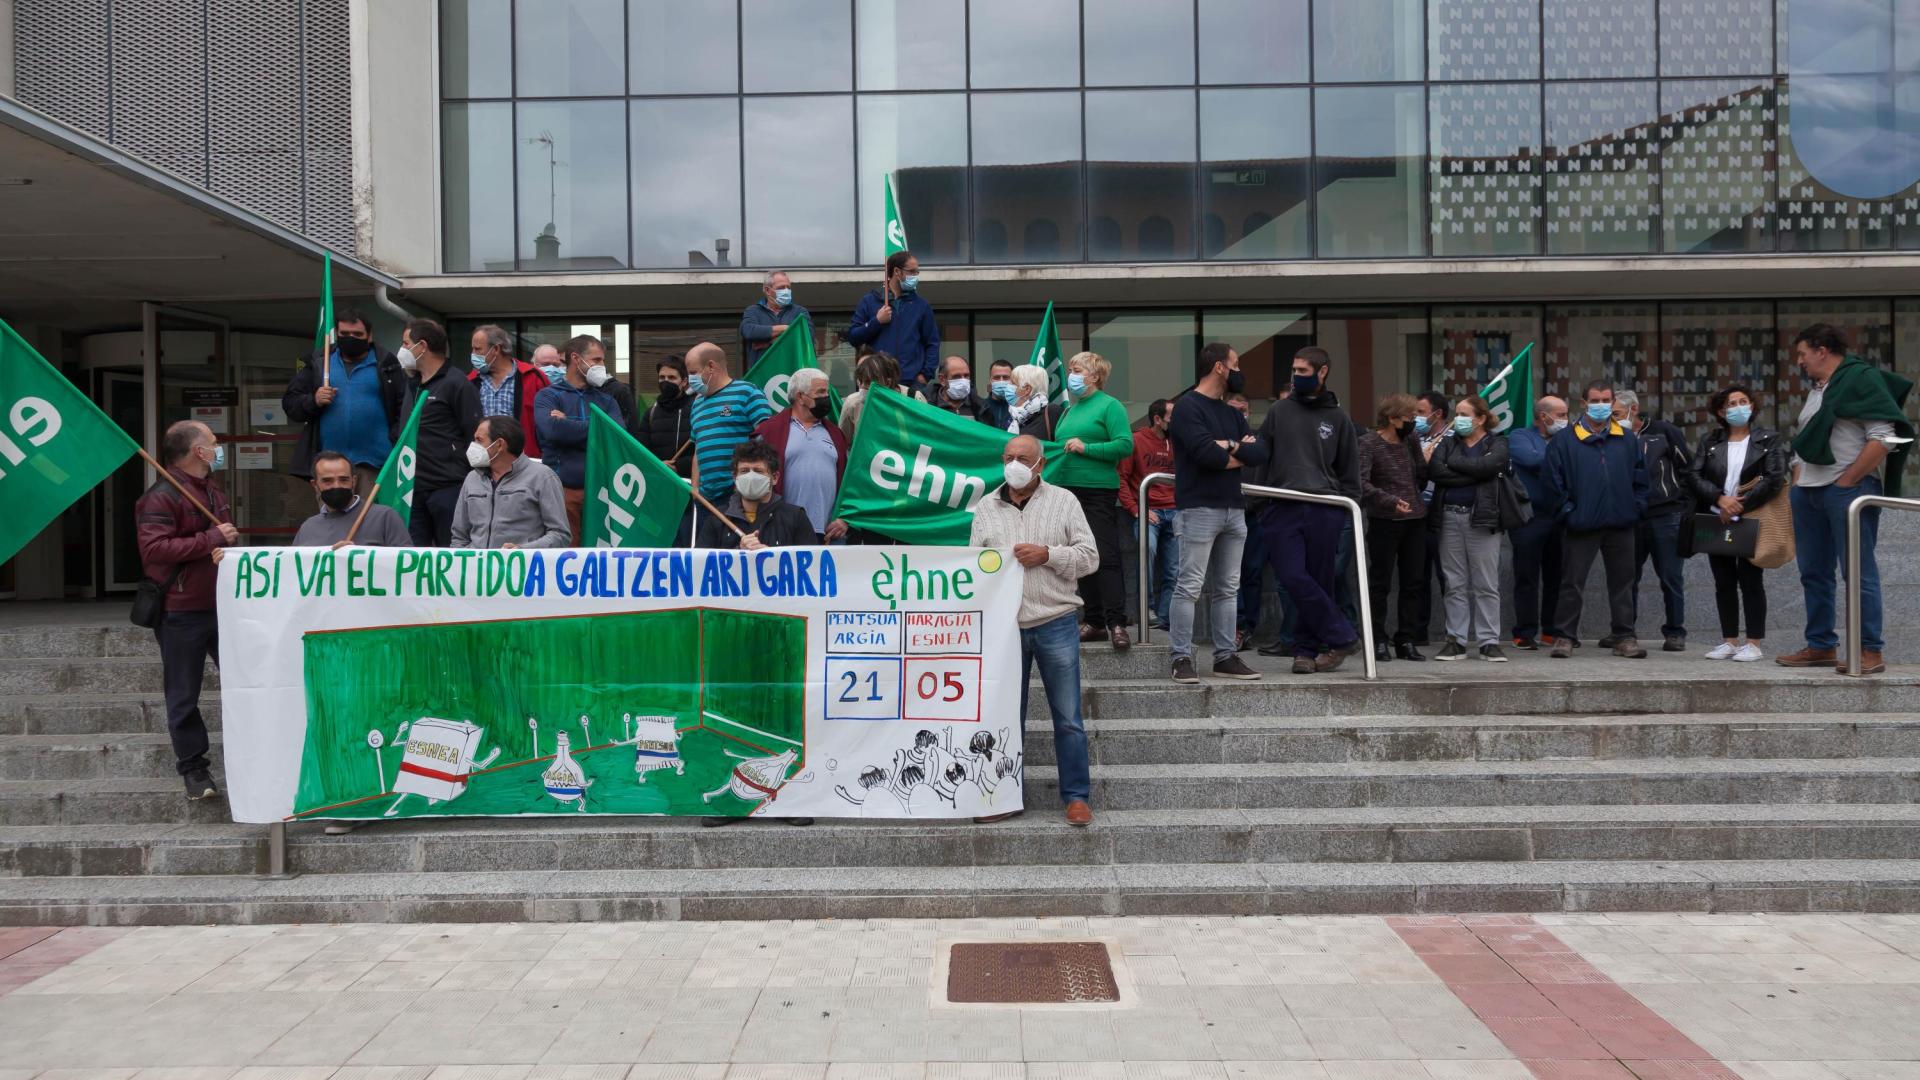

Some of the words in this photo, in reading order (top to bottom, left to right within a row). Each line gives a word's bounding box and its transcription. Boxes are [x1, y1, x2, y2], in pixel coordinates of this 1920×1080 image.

[235, 551, 283, 598] ASÍ
[295, 550, 335, 597] VA
[348, 550, 386, 596] EL
[556, 551, 693, 597] GALTZEN
[756, 550, 837, 597] GARA
[829, 613, 897, 626] PENTSUA
[907, 614, 972, 628] HARAGIA
[834, 630, 886, 645] ARGIA
[912, 632, 970, 647] ESNEA
[839, 671, 884, 702] 21
[917, 672, 964, 702] 05
[371, 733, 380, 744] 6
[406, 740, 460, 765] ESNEA
